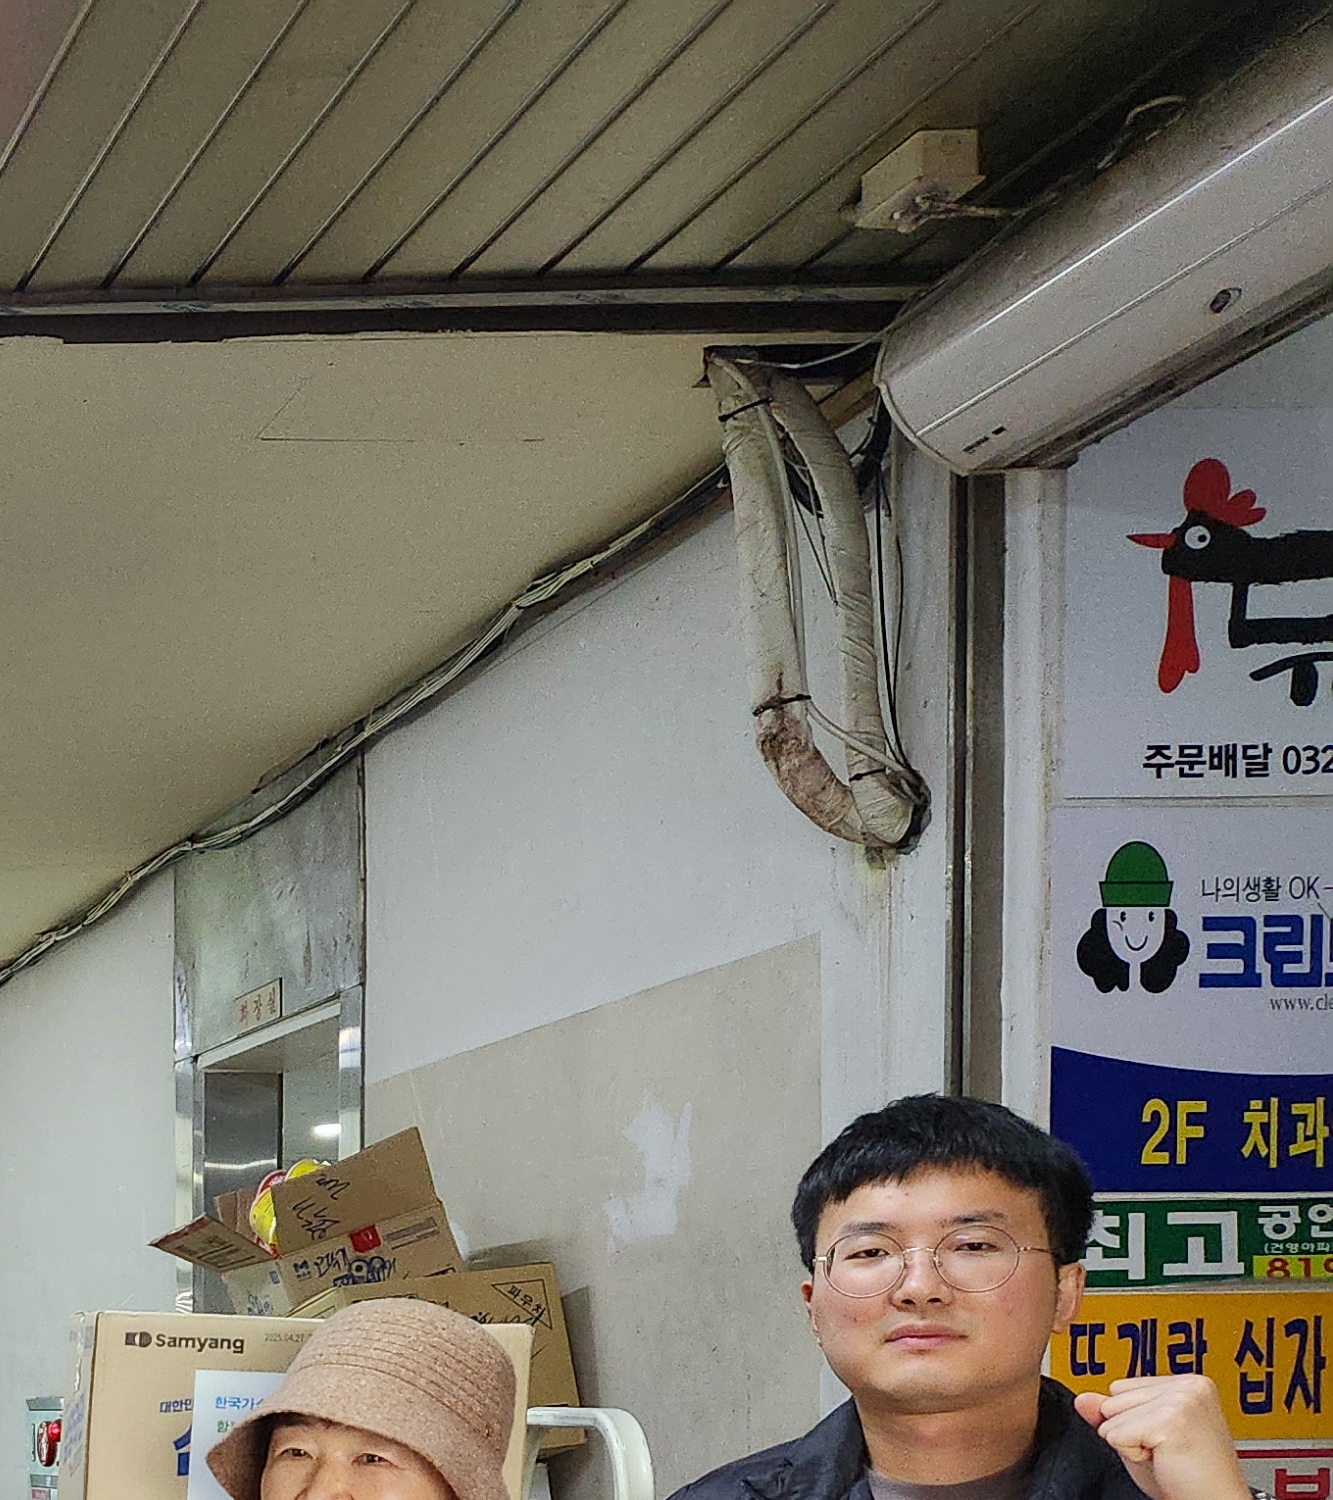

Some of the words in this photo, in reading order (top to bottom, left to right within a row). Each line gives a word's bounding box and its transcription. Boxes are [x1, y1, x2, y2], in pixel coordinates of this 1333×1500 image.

[1142, 743, 1272, 778] 주문배달
[1201, 876, 1282, 902] 나의생활
[1199, 914, 1333, 988] 크린
[1141, 1098, 1207, 1165] 2F
[1241, 1096, 1329, 1168] 치과
[1085, 1210, 1244, 1281] 최고
[155, 1333, 245, 1354] Samyang
[1234, 1316, 1326, 1414] 십자
